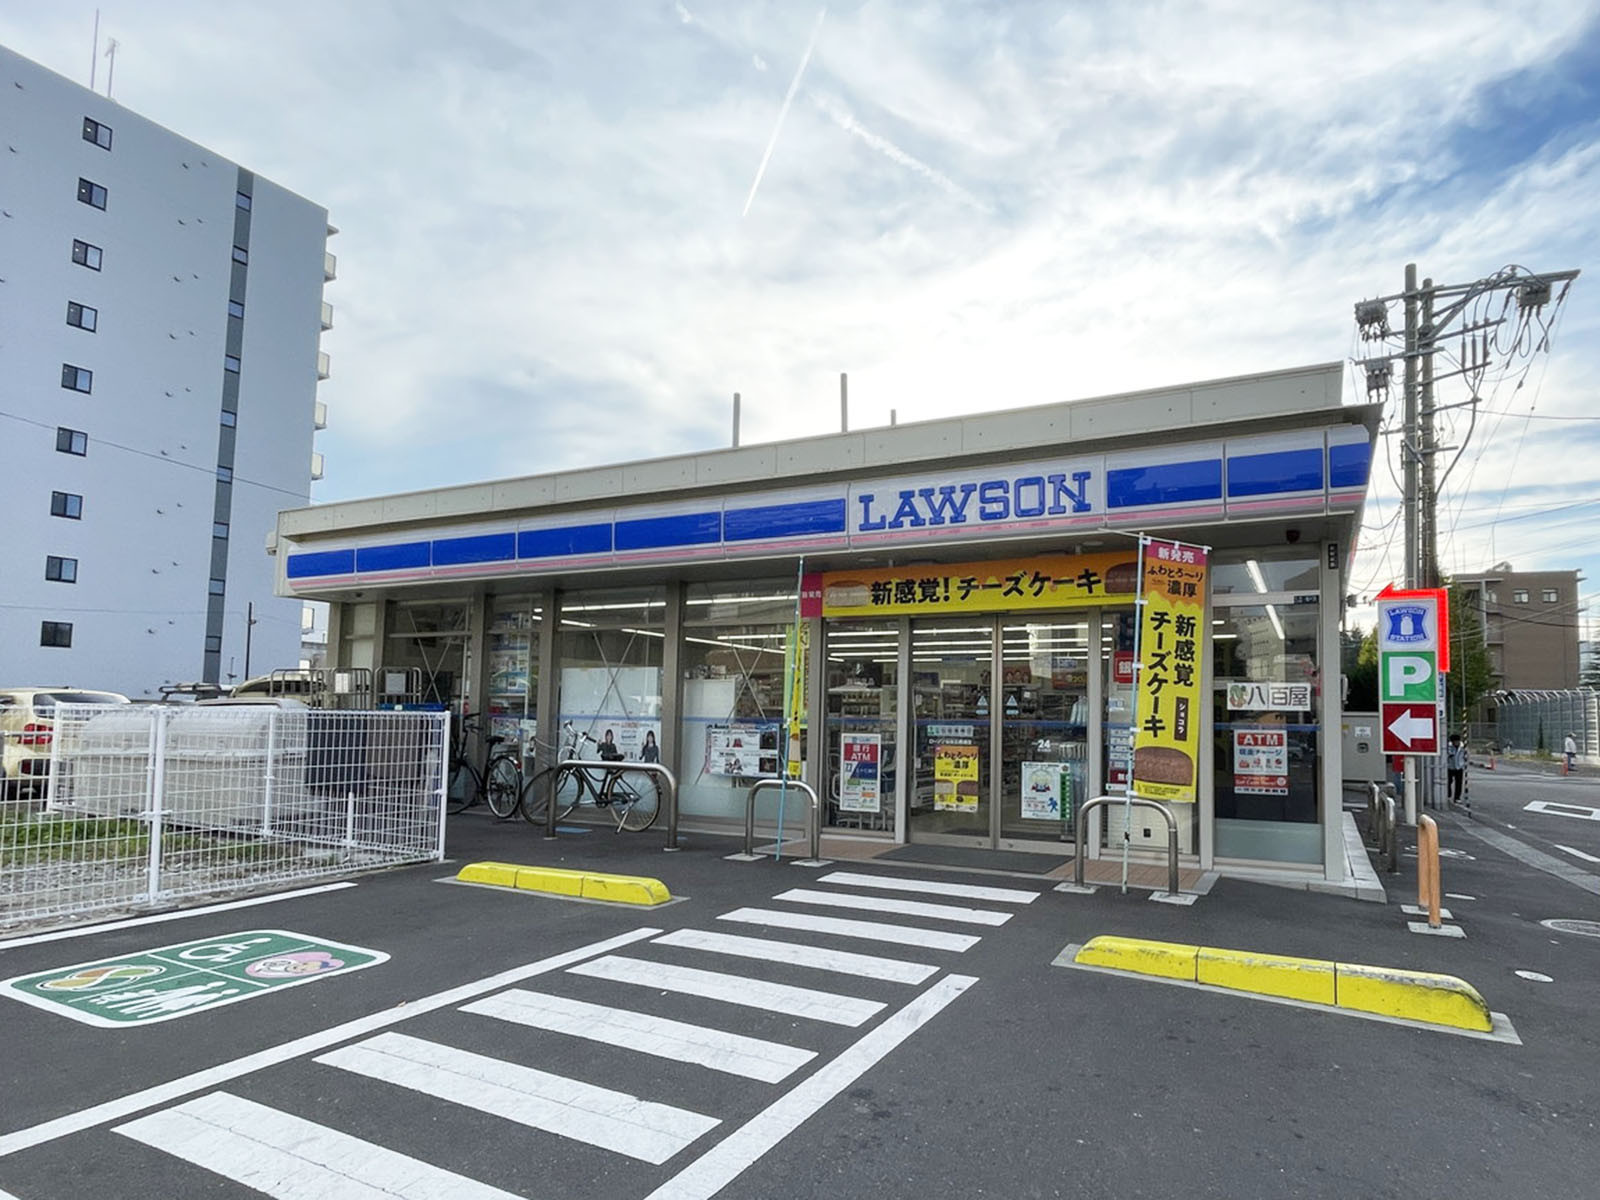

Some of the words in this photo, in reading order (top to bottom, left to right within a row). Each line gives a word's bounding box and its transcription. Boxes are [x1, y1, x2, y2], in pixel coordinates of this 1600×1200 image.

[858, 471, 1091, 531] LAWSON
[1158, 547, 1194, 563] 新発売
[1167, 580, 1197, 597] 濃厚
[1388, 607, 1425, 616] LAWSON
[1389, 633, 1425, 642] STATION
[1173, 614, 1196, 687] 新感覚
[1143, 611, 1171, 738] チーズケーキ
[1388, 656, 1432, 697] P
[1247, 685, 1309, 707] 八百屋
[1178, 702, 1187, 734] ショコラ
[1242, 734, 1279, 746] ATM
[851, 752, 871, 761] ATM
